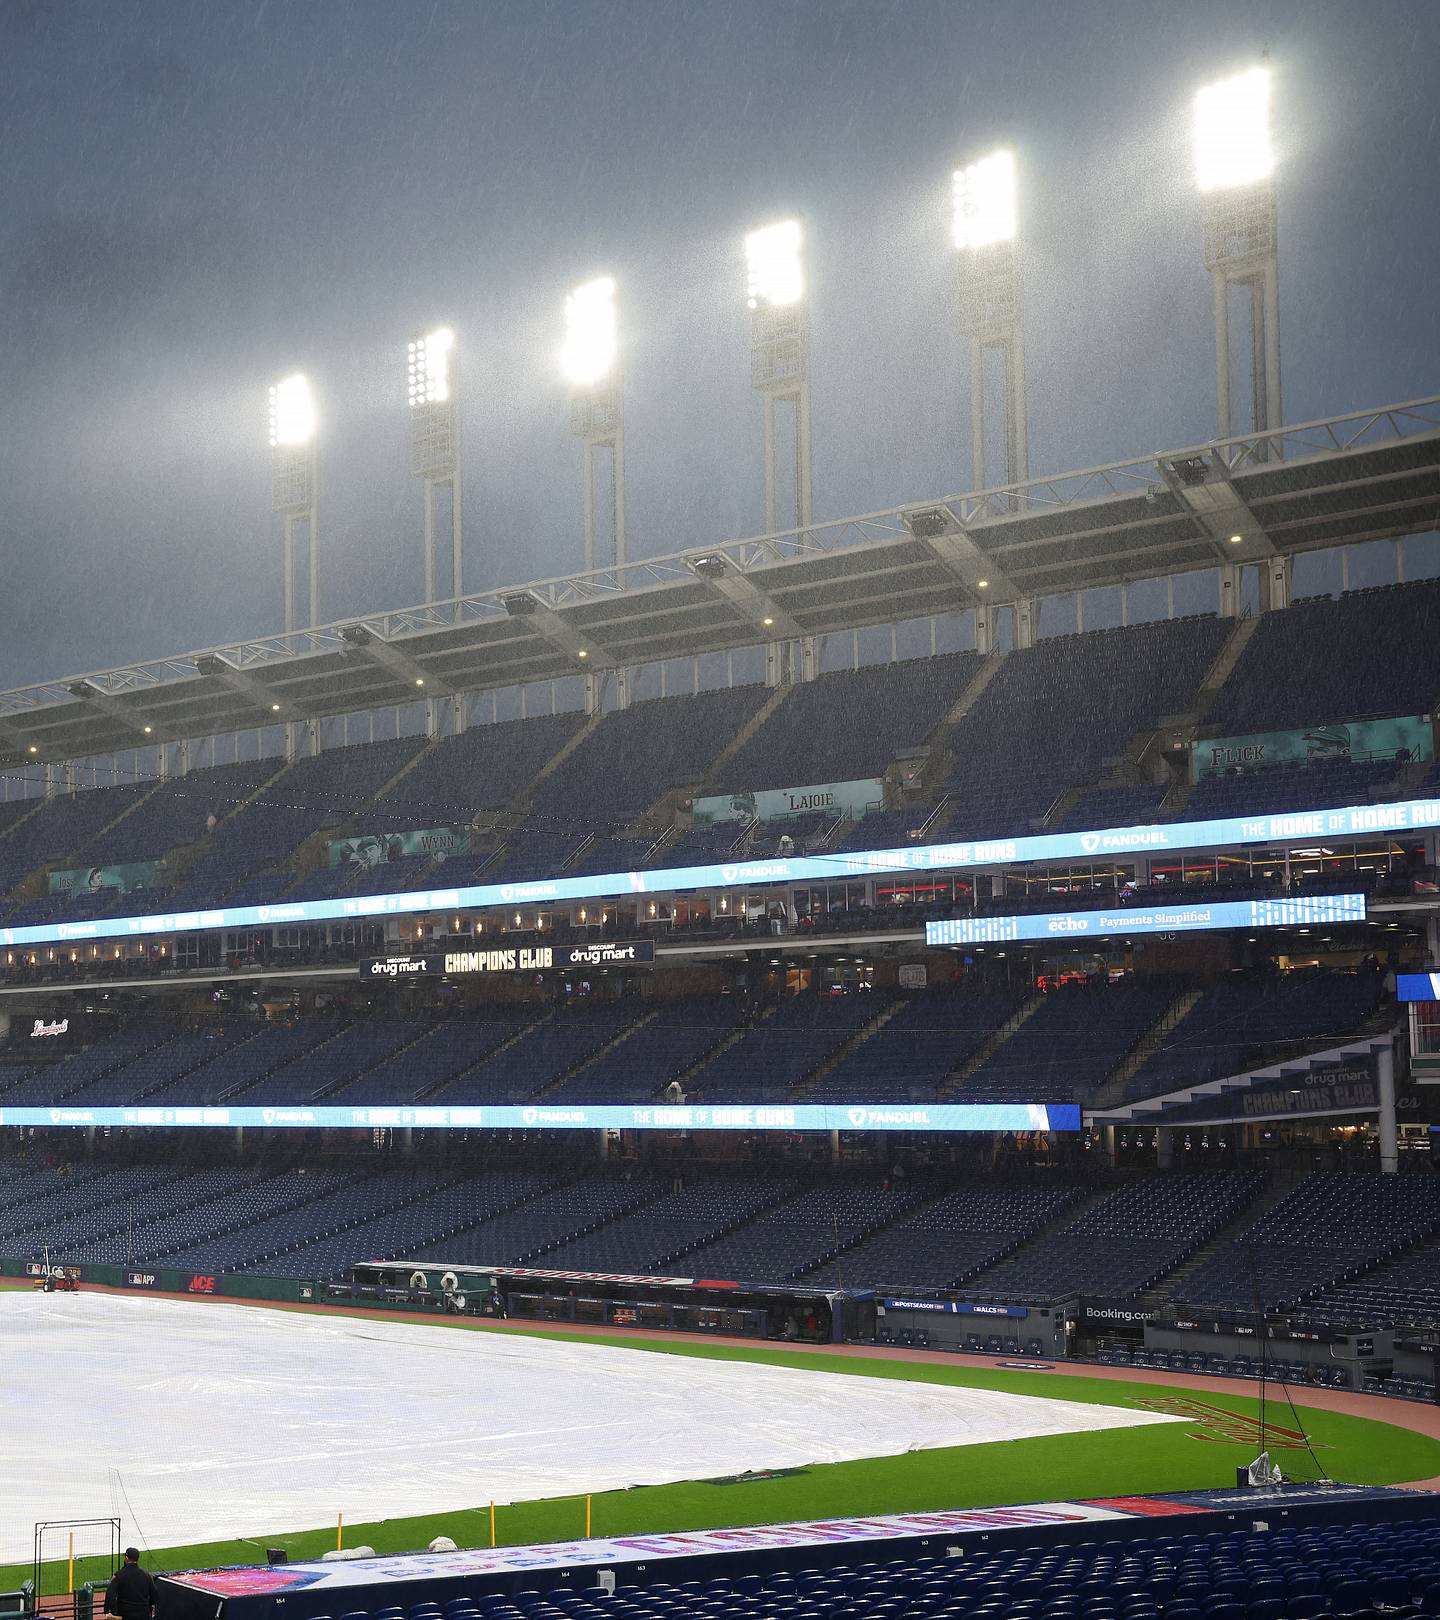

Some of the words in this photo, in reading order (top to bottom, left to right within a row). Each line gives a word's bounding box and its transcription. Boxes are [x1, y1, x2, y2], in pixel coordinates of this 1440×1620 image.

[1210, 744, 1265, 766] FLICK
[789, 792, 834, 811] LAJOIE
[1241, 823, 1265, 837] THE
[1270, 815, 1324, 836] HOME
[1329, 815, 1346, 829] OF
[1351, 807, 1407, 829] HOME
[421, 834, 456, 850] WYNN
[1103, 831, 1168, 847] FANDUEL
[739, 864, 790, 878] FANDUEL
[1099, 914, 1152, 929] Payments
[1154, 910, 1211, 925] Simplified
[445, 950, 516, 973] CHAMPIONS
[519, 947, 552, 968] CLUB
[570, 949, 601, 964] drug
[602, 946, 635, 961] mart
[371, 962, 397, 976] drug
[398, 959, 427, 972] mart
[1304, 1072, 1336, 1086] drug
[1338, 1069, 1372, 1082] mart
[1243, 1087, 1332, 1114] CHAMPIONS
[1334, 1083, 1375, 1107] CLUB
[868, 1111, 931, 1123] FANDUEL
[142, 1274, 155, 1285] APP
[189, 1274, 215, 1289] ACE
[981, 1306, 997, 1314] ALCS
[613, 1508, 1088, 1555] CLEVELAND
